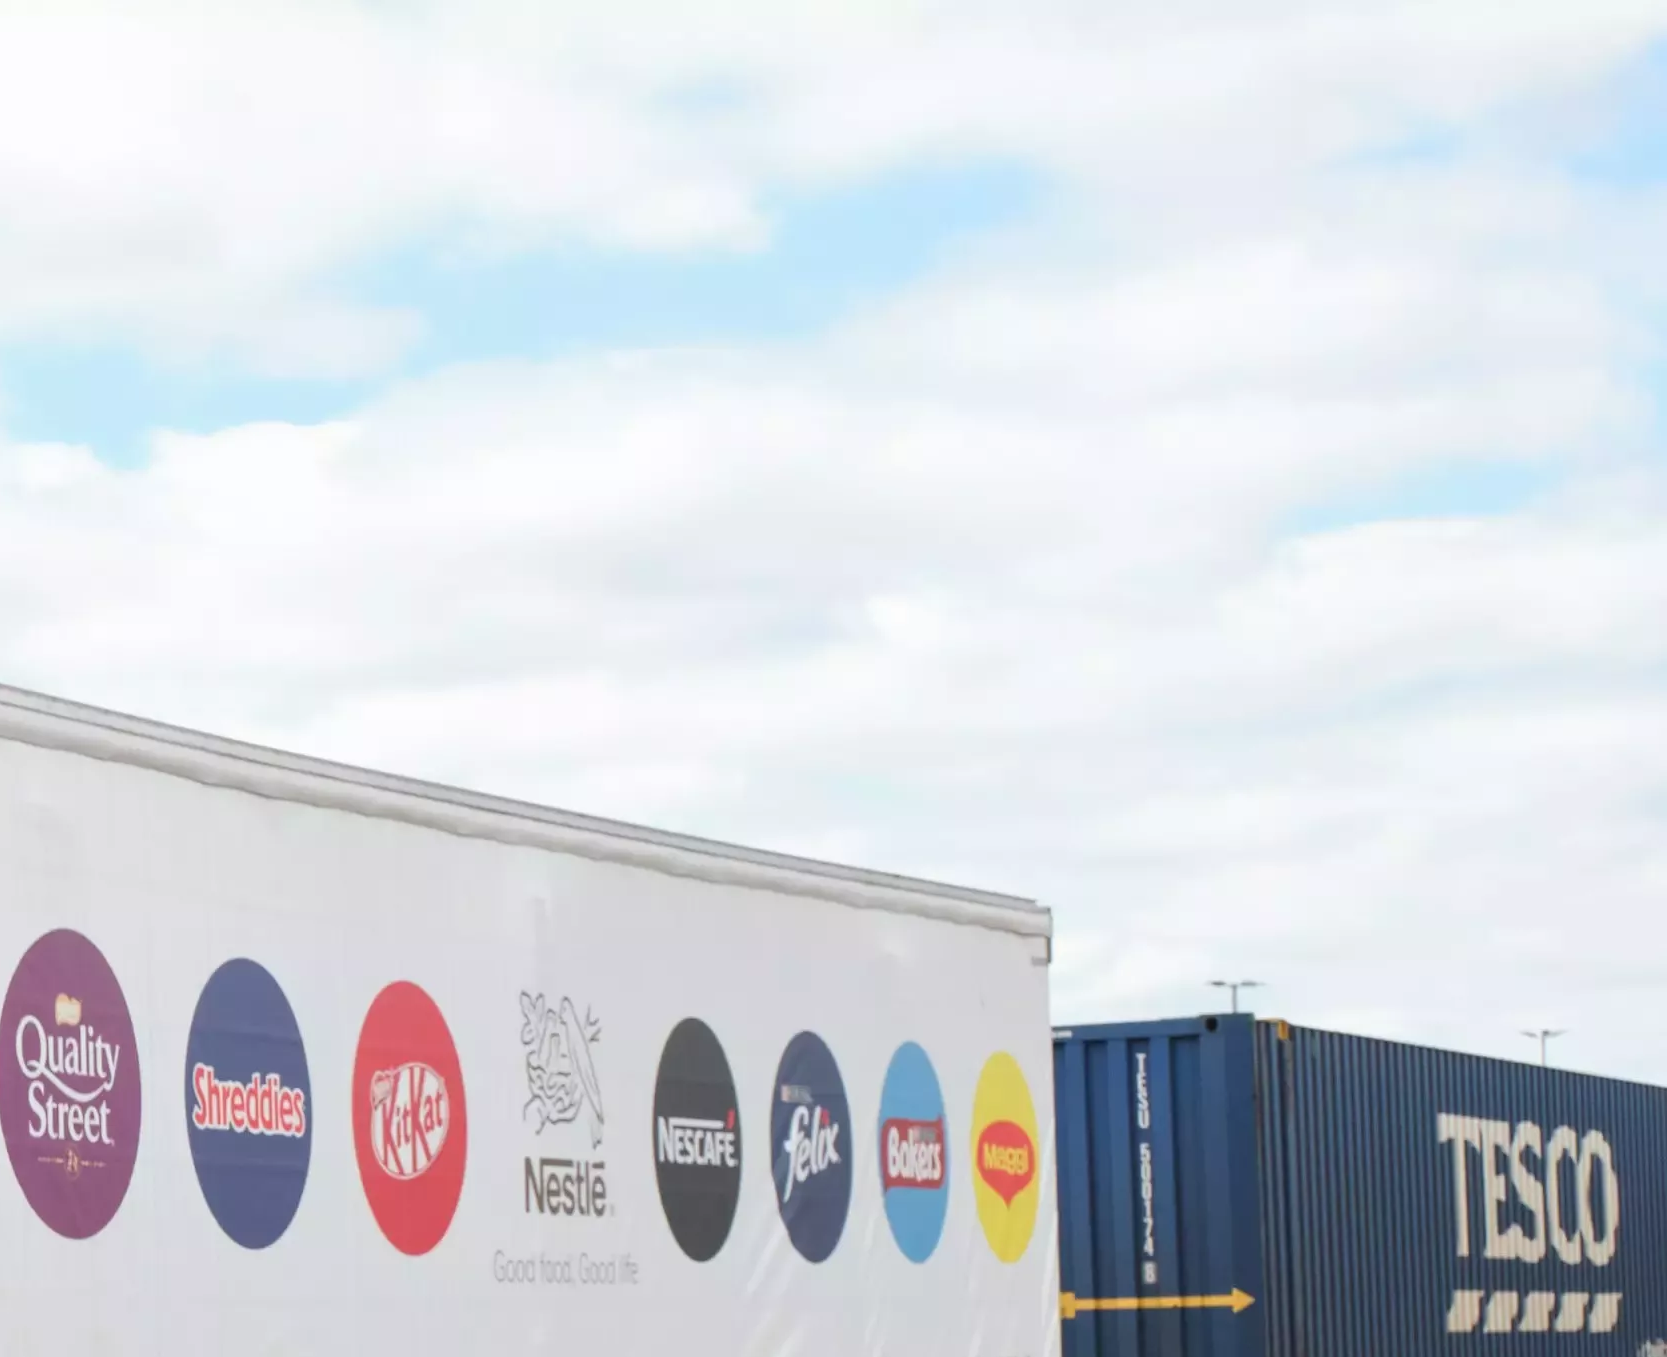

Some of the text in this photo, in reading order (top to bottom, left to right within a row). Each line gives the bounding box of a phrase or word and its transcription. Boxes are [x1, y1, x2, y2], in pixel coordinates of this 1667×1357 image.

[15, 1014, 121, 1103] Quality
[1135, 1053, 1150, 1129] TESU
[28, 1080, 114, 1146] Street
[192, 1062, 305, 1136] Shreddies
[380, 1065, 444, 1175] KitKat
[524, 1156, 606, 1218] Nestlé
[783, 1104, 841, 1203] felix
[887, 1126, 942, 1182] Bakers
[1436, 1112, 1619, 1267] TESCO
[493, 1250, 536, 1284] Good
[578, 1252, 616, 1285] Good
